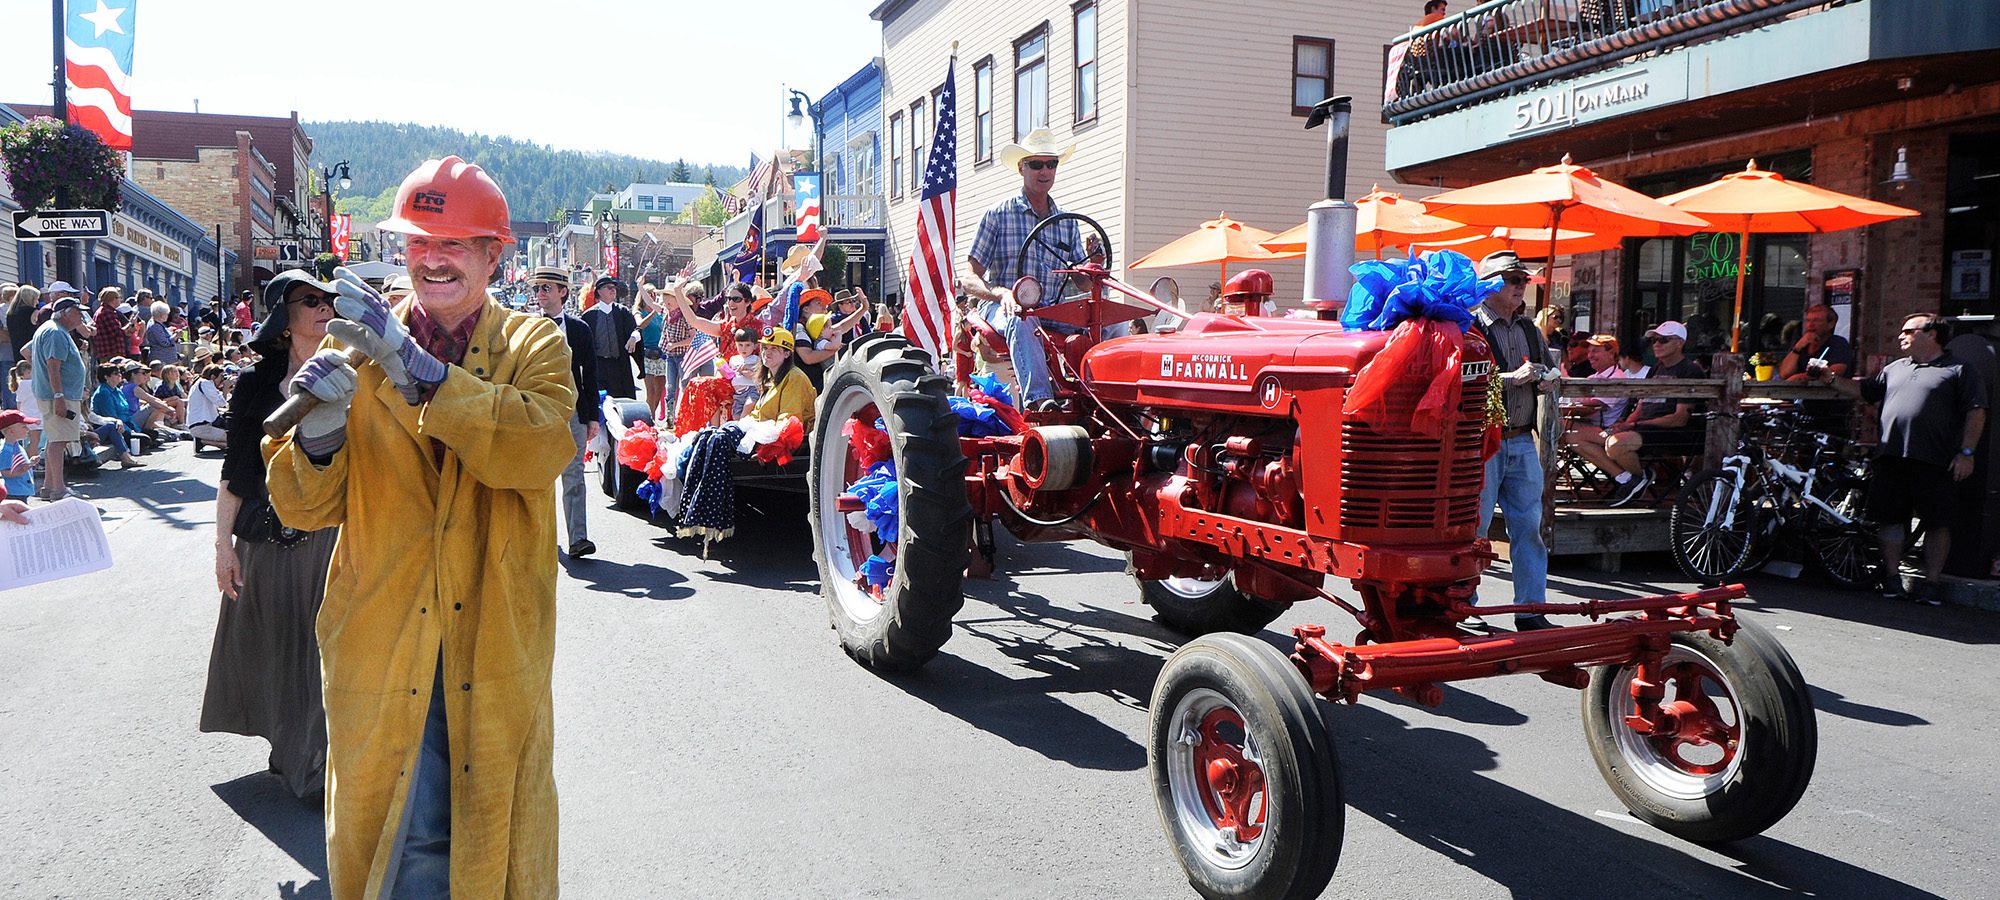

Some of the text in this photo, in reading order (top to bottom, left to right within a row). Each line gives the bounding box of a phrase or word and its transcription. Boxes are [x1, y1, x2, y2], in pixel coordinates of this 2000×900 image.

[1514, 82, 1648, 129] 501 ON MAIN
[414, 192, 445, 205] Pro
[42, 218, 98, 230] ONE WAY
[127, 226, 148, 248] STATES
[149, 237, 162, 255] POST
[163, 244, 180, 263] OFFICE
[1711, 260, 1752, 279] MAN
[1175, 362, 1249, 380] FARMALL
[1265, 383, 1276, 402] H
